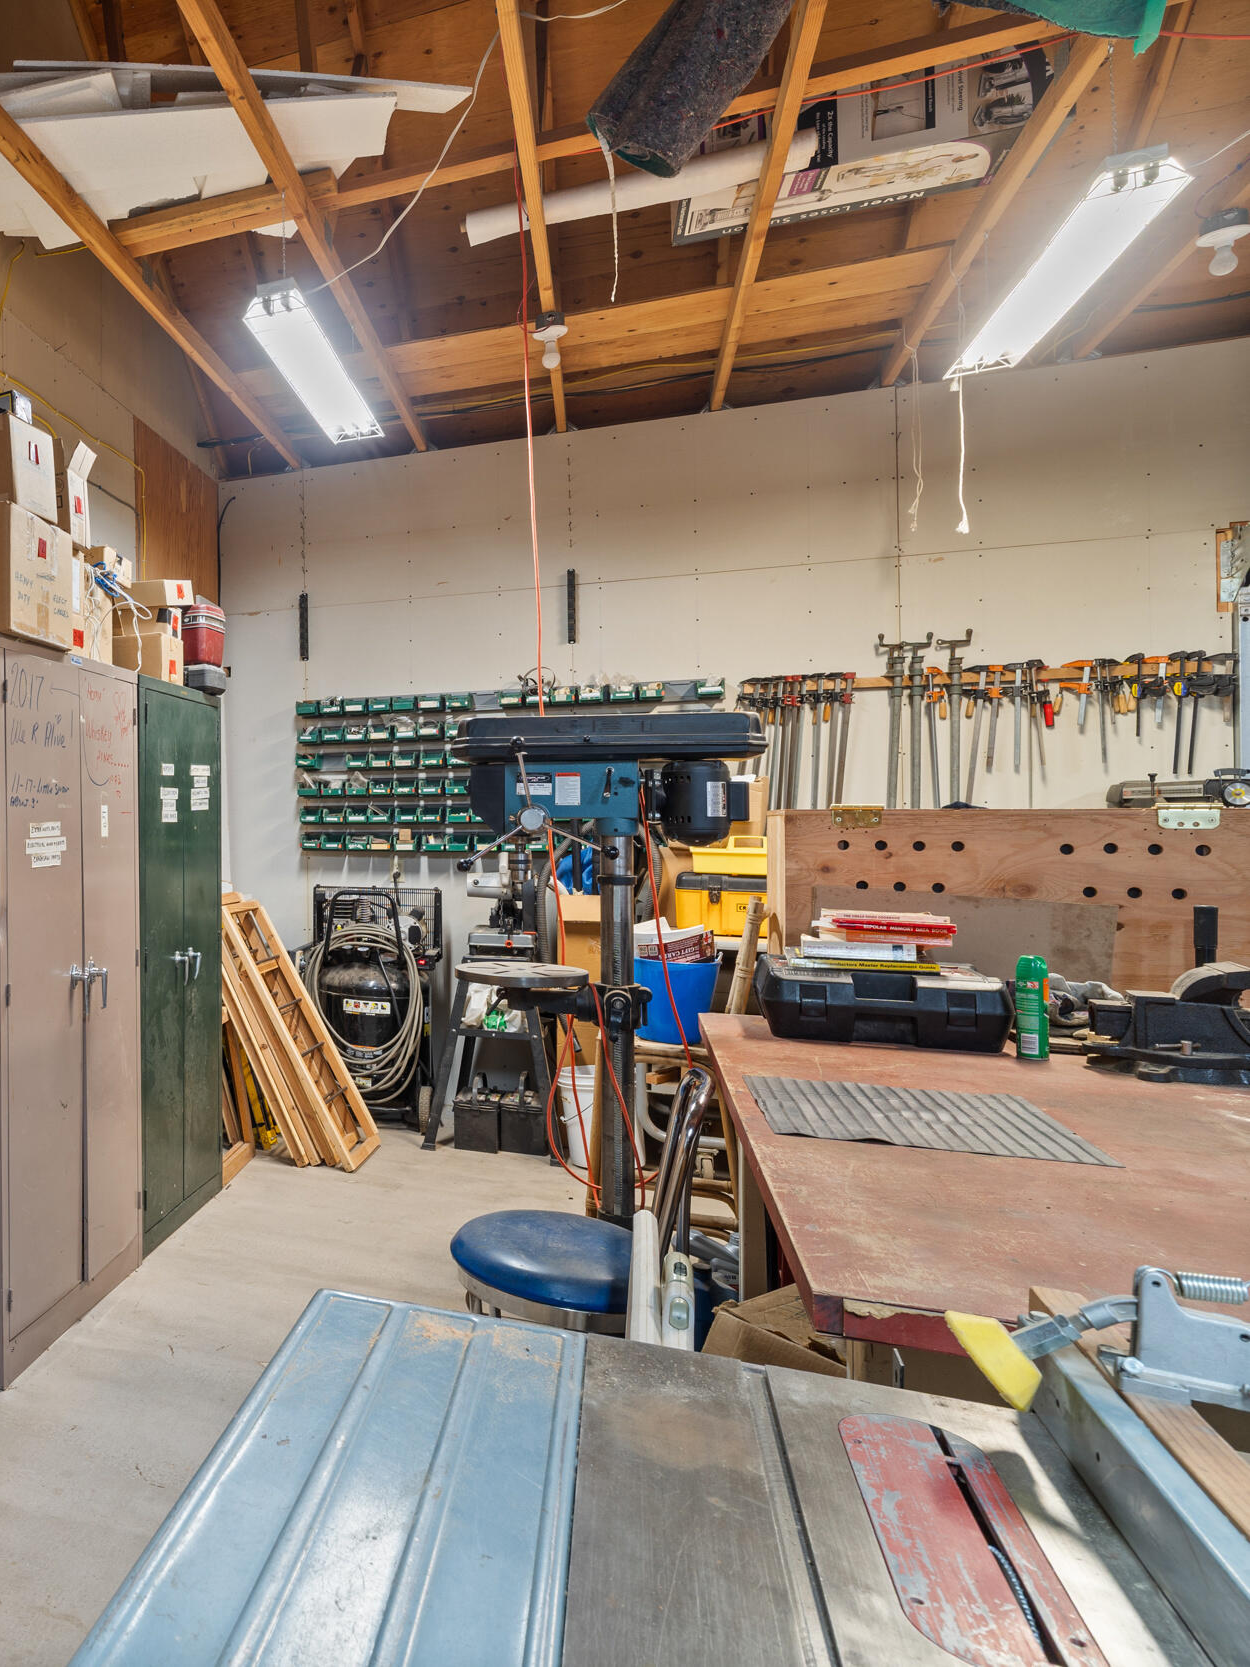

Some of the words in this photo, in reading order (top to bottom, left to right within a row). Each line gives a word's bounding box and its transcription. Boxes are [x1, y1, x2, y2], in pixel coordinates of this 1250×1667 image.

[859, 190, 925, 208] Never
[800, 205, 850, 220] Loses
[10, 662, 44, 712] 2017
[10, 718, 26, 745] We
[31, 722, 39, 745] R
[682, 946, 696, 955] GIFT
